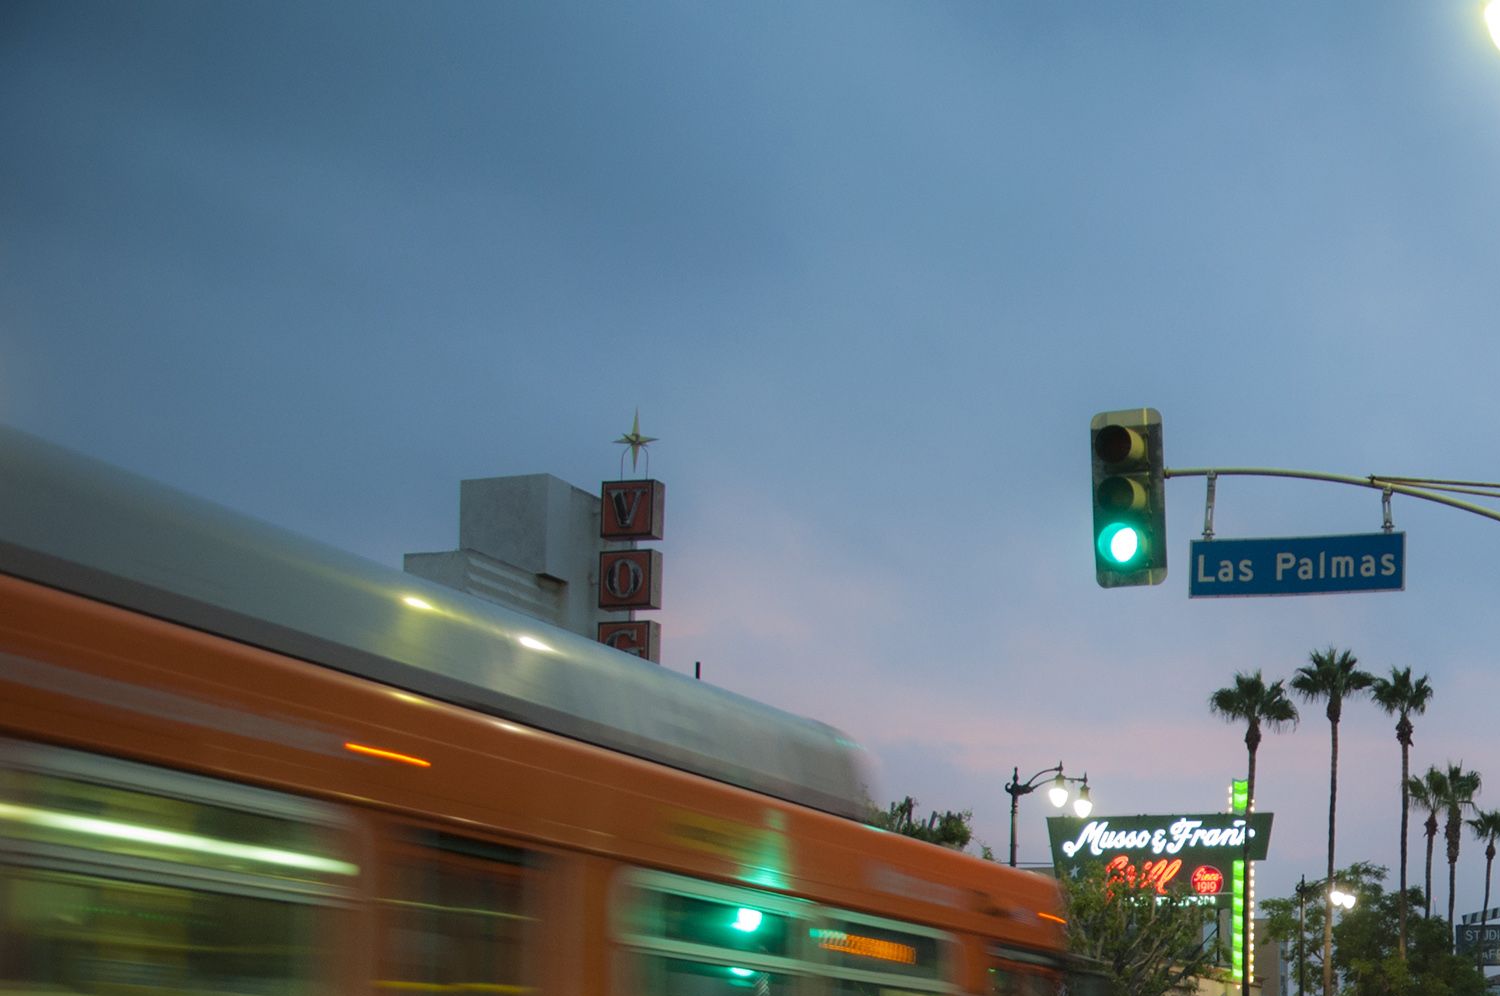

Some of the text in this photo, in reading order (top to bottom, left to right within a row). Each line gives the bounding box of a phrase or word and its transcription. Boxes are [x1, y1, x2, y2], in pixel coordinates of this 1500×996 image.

[1197, 550, 1397, 583] Las Palmas
[1062, 820, 1152, 858] Musso
[1152, 828, 1167, 855] &
[1196, 881, 1218, 893] 1919
